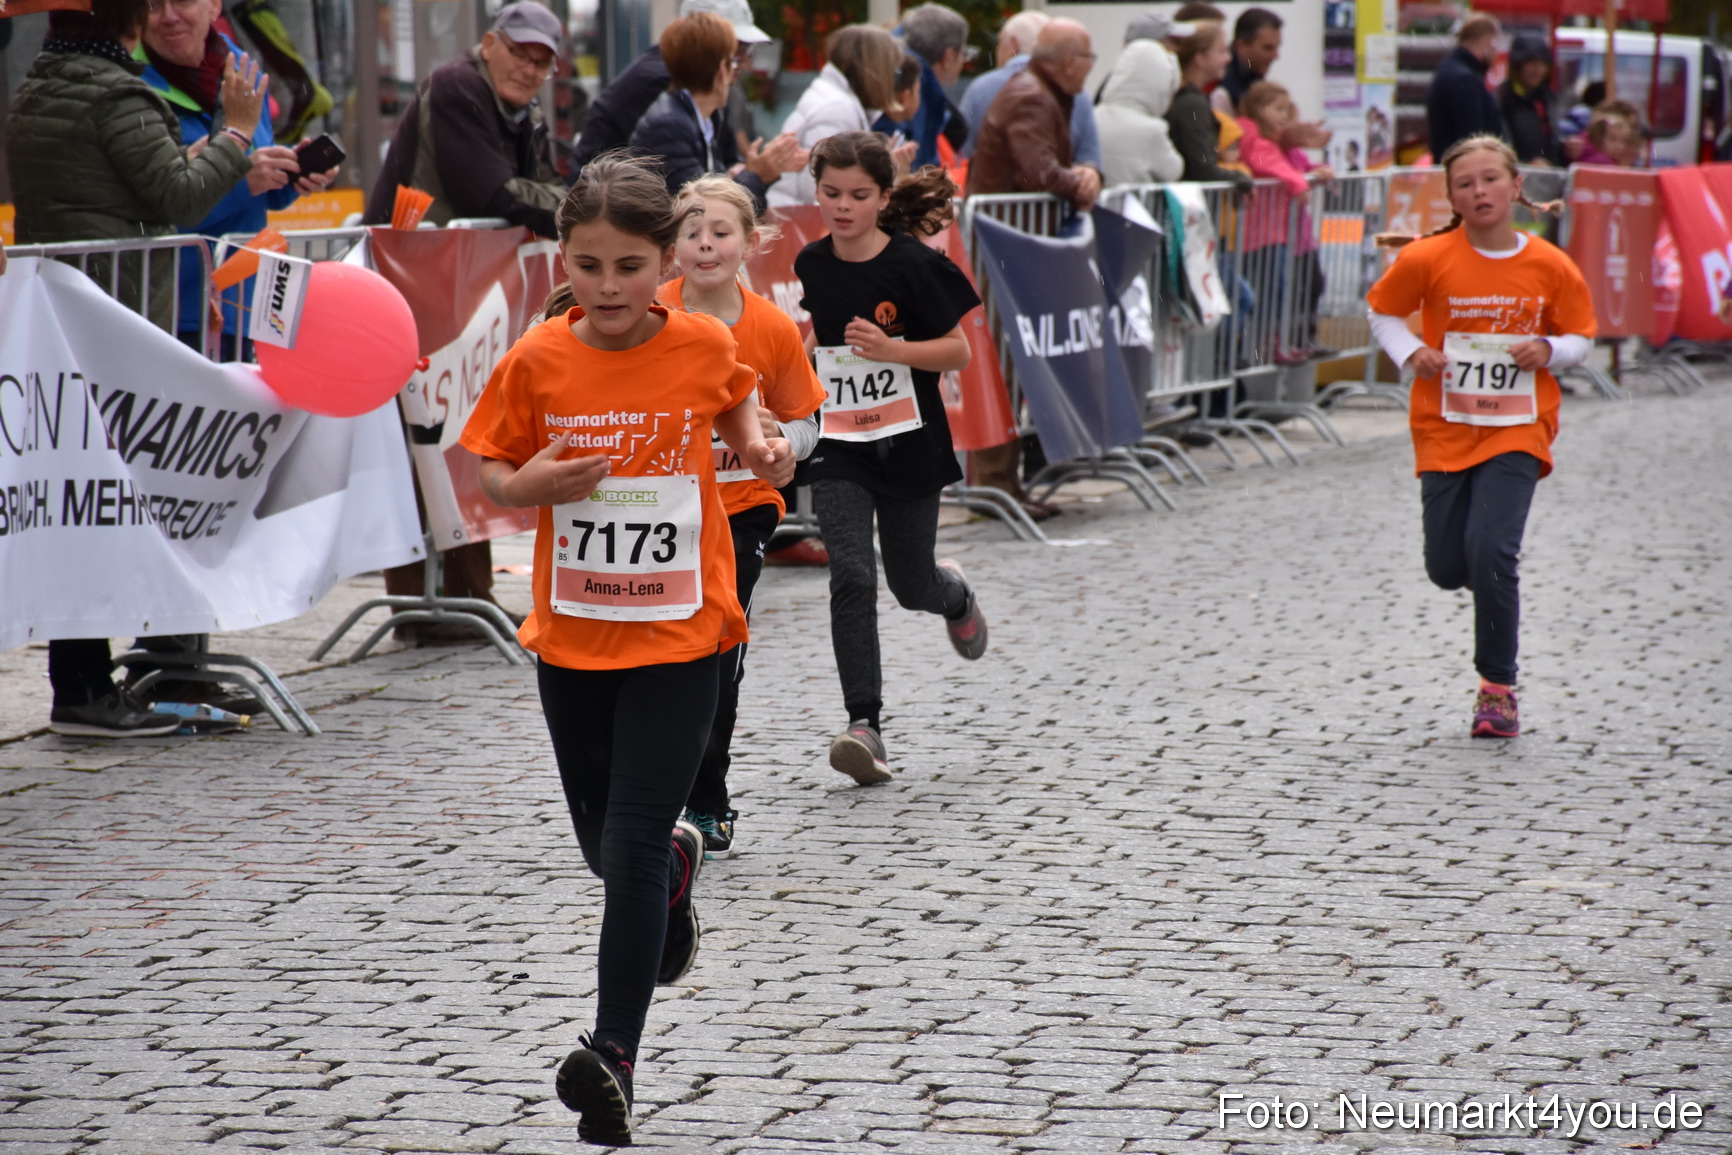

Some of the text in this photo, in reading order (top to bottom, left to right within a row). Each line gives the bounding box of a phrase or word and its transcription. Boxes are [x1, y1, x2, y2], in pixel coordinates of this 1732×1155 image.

[271, 260, 291, 311] swn
[1448, 295, 1517, 306] Neumarkter
[1450, 307, 1503, 319] Stadtlauf
[1457, 361, 1521, 390] 7197
[829, 369, 898, 405] 7142
[1476, 399, 1499, 410] Mira
[544, 410, 647, 428] Neumarkter
[854, 412, 881, 426] Luisa
[547, 431, 625, 449] Stdtlauf
[604, 490, 658, 503] BOCK
[572, 519, 677, 565] 7173
[558, 552, 568, 562] B5
[584, 578, 664, 596] Anna-Lena
